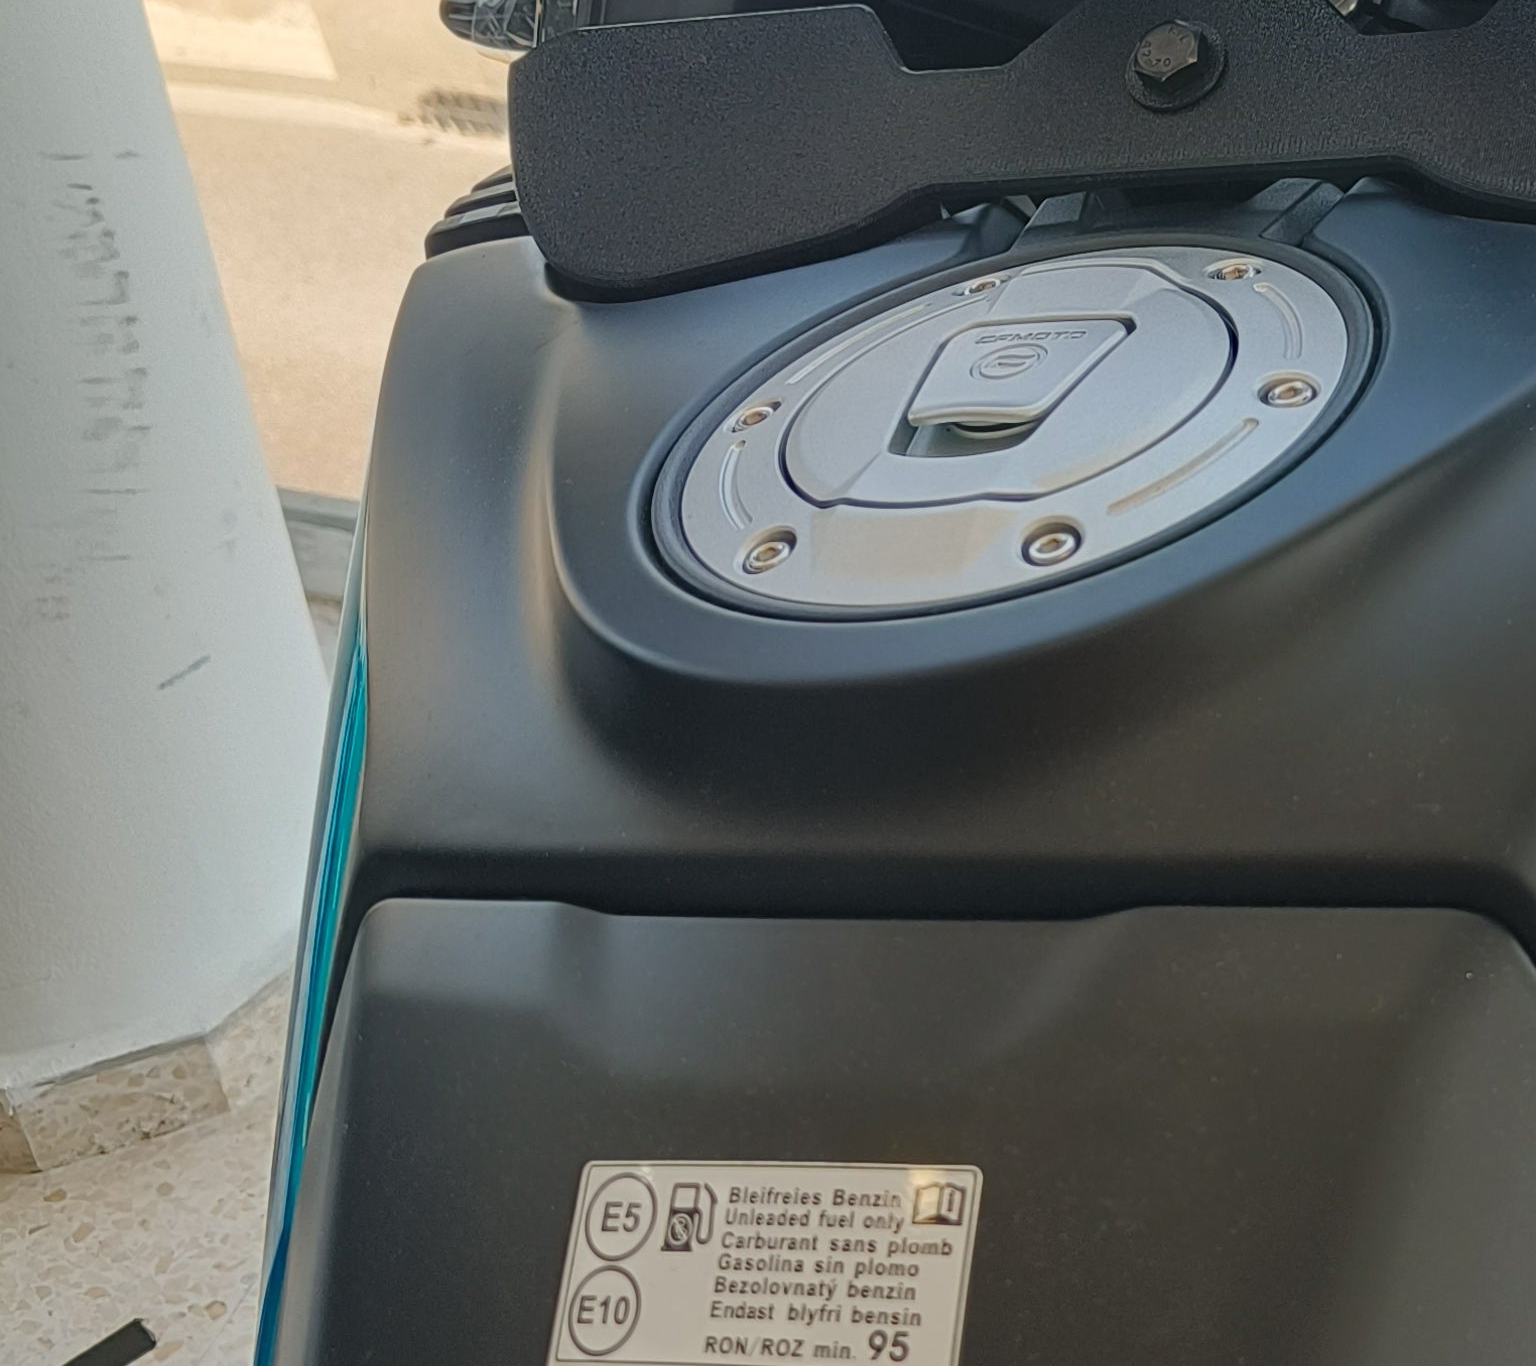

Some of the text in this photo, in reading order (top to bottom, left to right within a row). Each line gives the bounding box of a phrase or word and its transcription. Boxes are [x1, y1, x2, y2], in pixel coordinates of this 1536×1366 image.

[728, 1186, 902, 1208] Bleifreies Benzin
[600, 1201, 642, 1233] E5
[724, 1207, 904, 1234] Unleaded fuel only
[721, 1231, 953, 1258] Carburant sans plomb
[718, 1253, 920, 1279] Gasolina sin plomo
[714, 1276, 916, 1302] Bezolovnatý benzin
[576, 1294, 631, 1325] E10
[709, 1300, 922, 1327] Endast blyfri bensin
[704, 1329, 910, 1363] RON/ROZ min. 95
